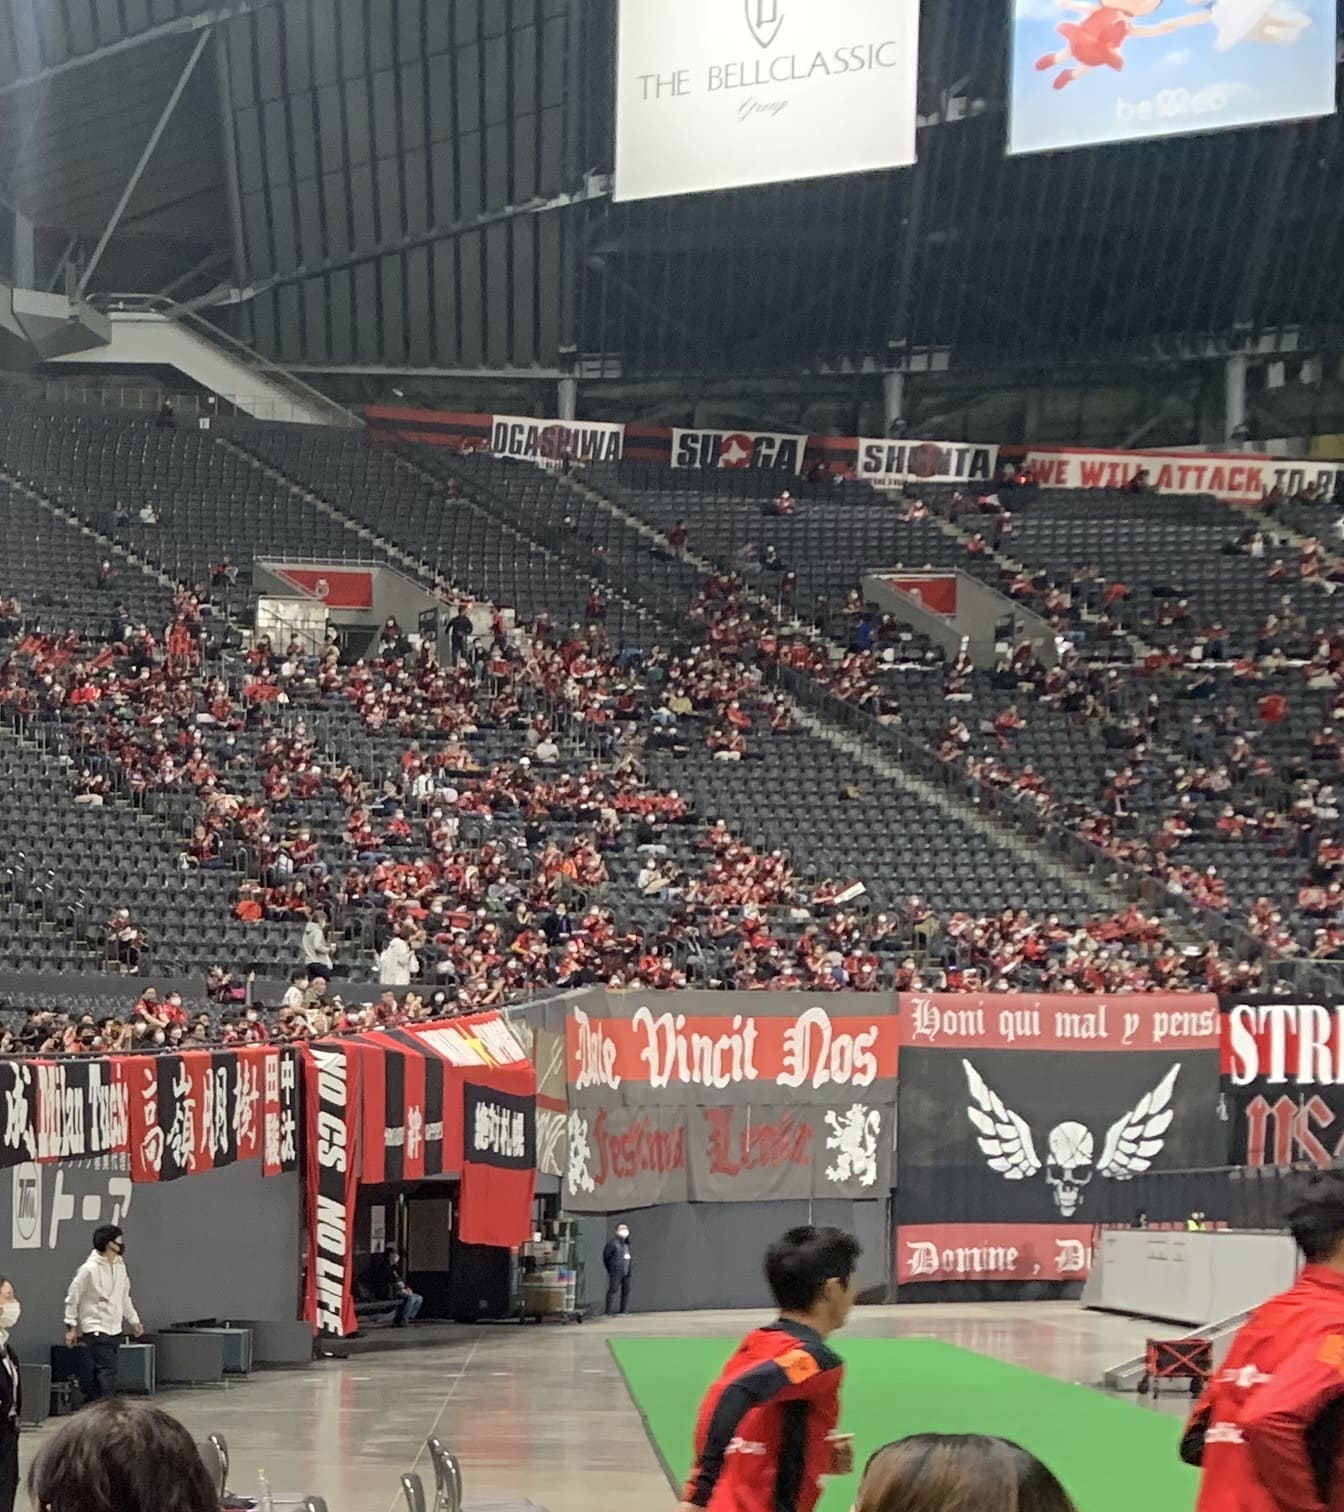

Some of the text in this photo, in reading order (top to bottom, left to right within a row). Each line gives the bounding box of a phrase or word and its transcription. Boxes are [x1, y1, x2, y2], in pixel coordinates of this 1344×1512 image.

[636, 41, 896, 100] THE BELLCLASSIC
[1032, 459, 1069, 484] WE
[1157, 464, 1263, 492] ATTACK
[632, 1006, 758, 1089] Vincit
[776, 1007, 878, 1089] Nos
[912, 997, 986, 1042] Honi
[998, 1000, 1042, 1042] qui
[1055, 1003, 1109, 1039] mal
[1229, 1004, 1344, 1086] STR
[38, 1064, 85, 1158] Milan
[313, 1049, 347, 1337] NO CS NO LIFE
